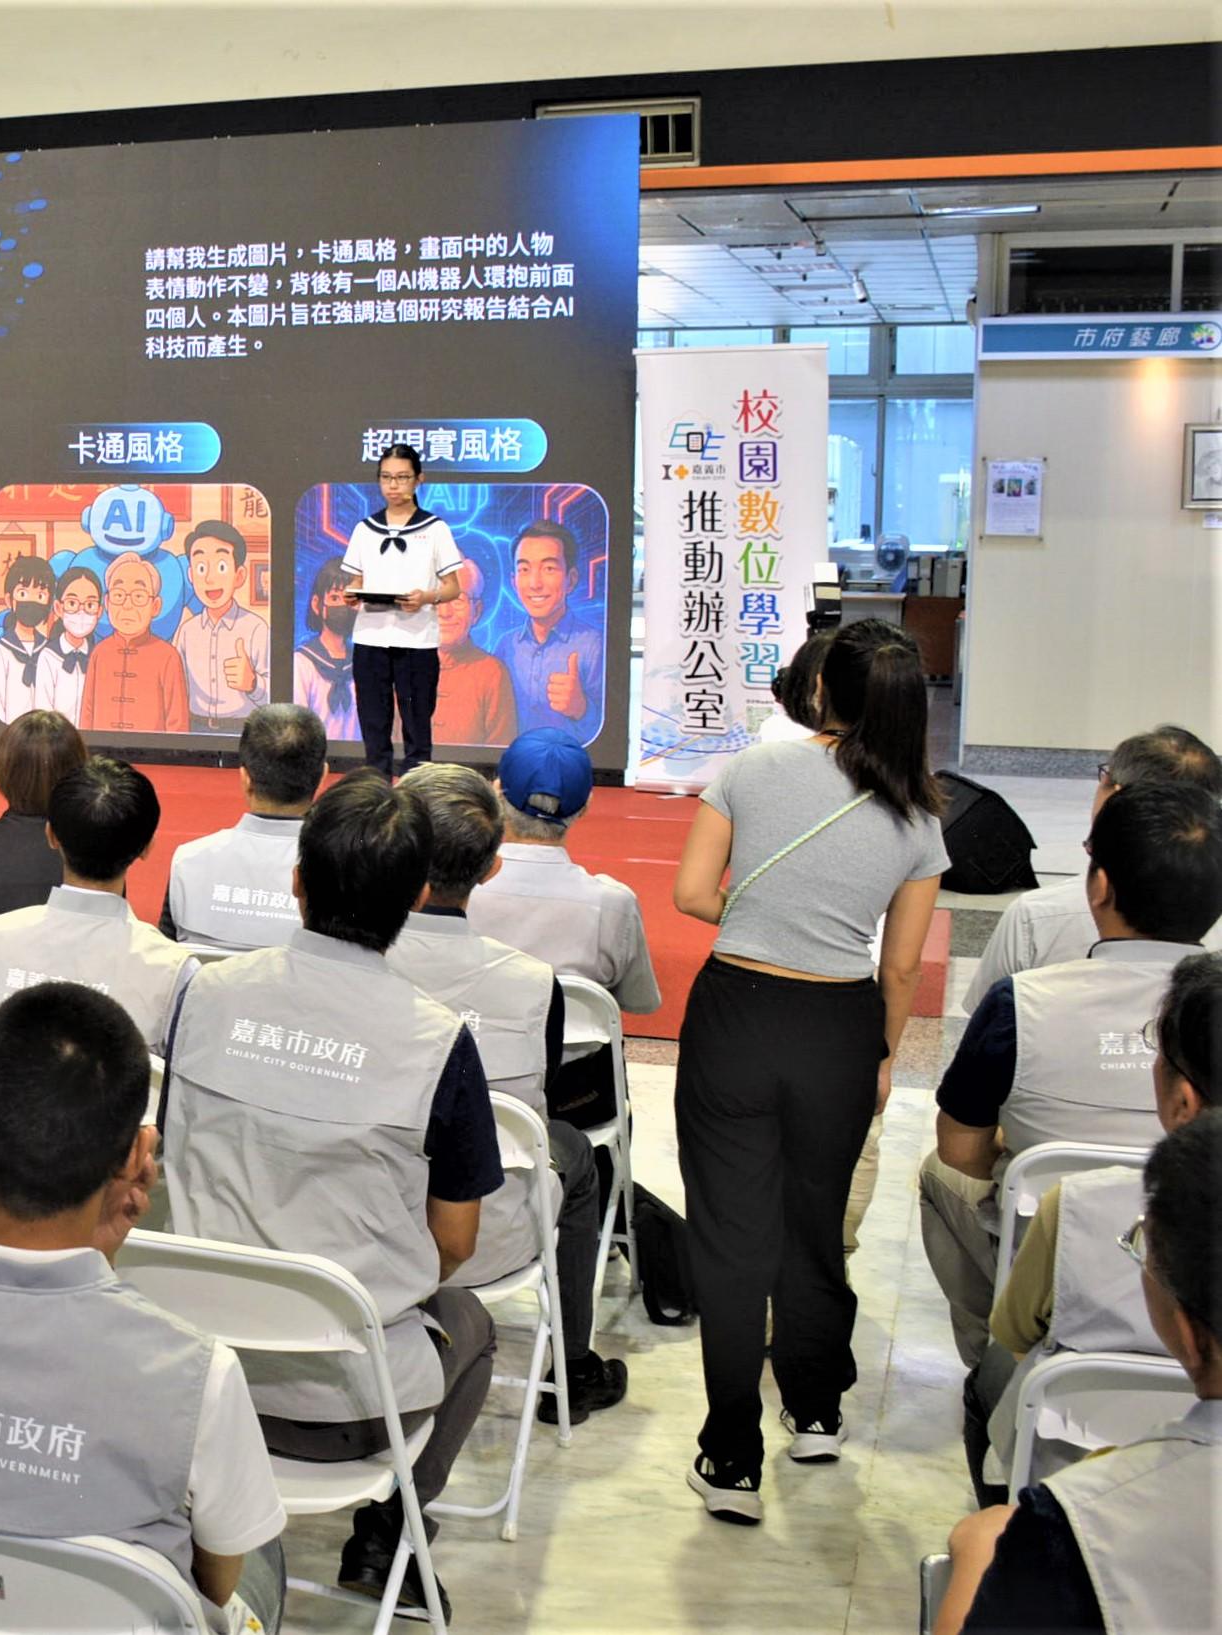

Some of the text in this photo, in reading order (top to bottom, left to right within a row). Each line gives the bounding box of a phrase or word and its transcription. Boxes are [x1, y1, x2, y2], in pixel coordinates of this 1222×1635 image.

[145, 232, 554, 271] 請幫我生成圖片，卡通風格，畫面中的人物
[145, 263, 575, 301] 表情動作不變，背後有一個AI機器人環抱前面
[145, 294, 575, 331] 四個人。本圖片旨在強調這個研究報告結合AI
[145, 333, 264, 360] 科技而產生。
[1074, 327, 1182, 348] 市府藝廊
[68, 430, 184, 466] 卡通風格
[361, 427, 523, 462] 超現實風格
[102, 499, 147, 532] AI
[240, 487, 269, 519] 龍
[736, 389, 780, 684] 校園數位學習
[682, 489, 725, 731] 推動辦公室
[229, 1018, 370, 1069] 嘉義市政府
[225, 1047, 361, 1084] CHIAYI CITY GOVERNMENT
[1099, 1062, 1137, 1070] CHIAYI
